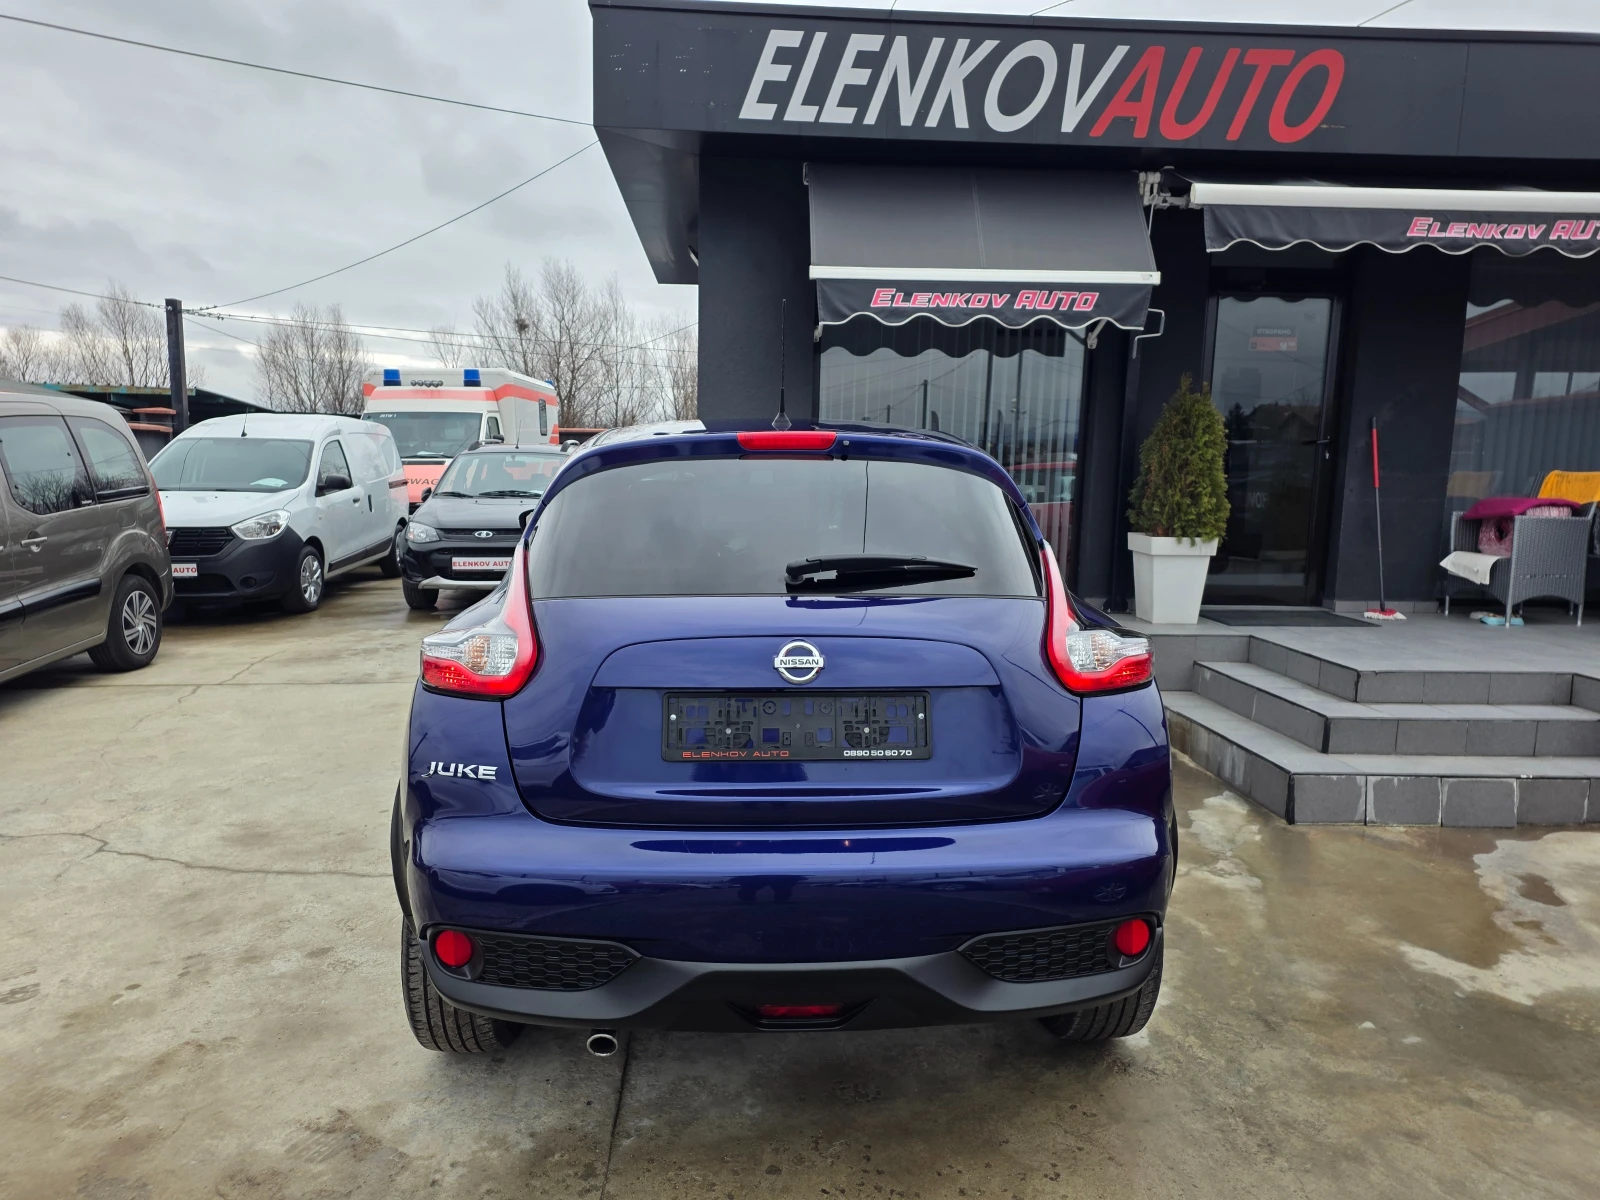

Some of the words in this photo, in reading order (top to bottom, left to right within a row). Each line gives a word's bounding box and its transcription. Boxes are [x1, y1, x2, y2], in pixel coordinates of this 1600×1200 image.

[1406, 216, 1547, 240] ELENKOV
[870, 287, 1012, 309] ELENKOV
[1013, 289, 1100, 312] AUTO
[779, 658, 819, 666] NISSAN
[420, 761, 499, 780] JUKE
